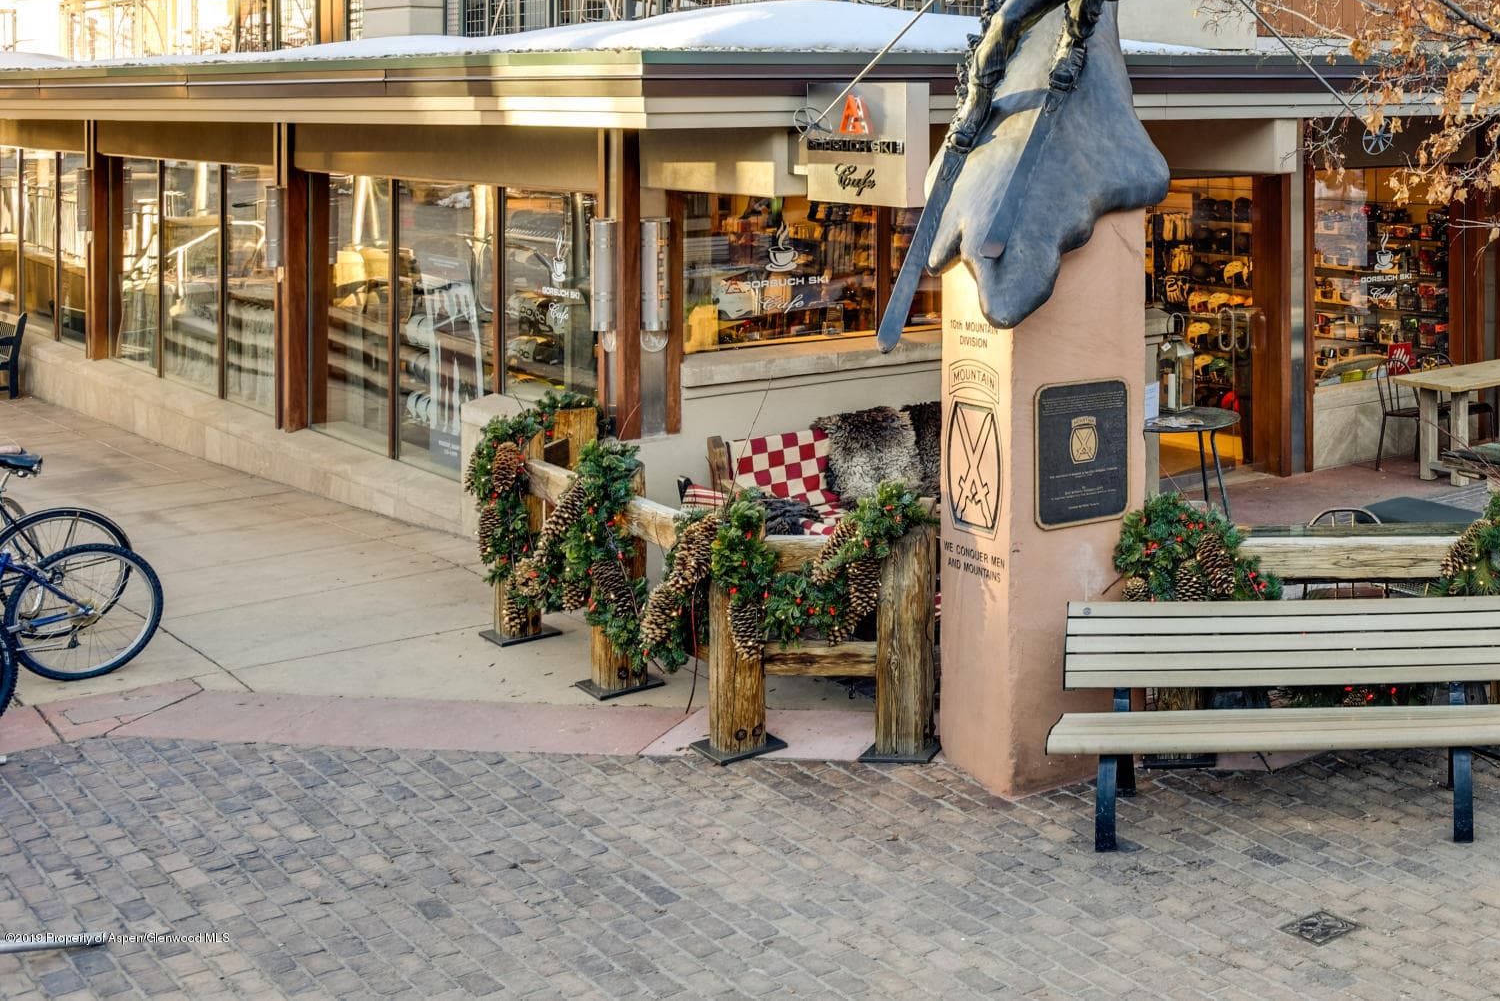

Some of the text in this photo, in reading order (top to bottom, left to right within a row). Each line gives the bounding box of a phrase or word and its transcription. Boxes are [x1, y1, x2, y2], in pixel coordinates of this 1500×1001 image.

[743, 275, 829, 289] GORSUCH SKI
[759, 294, 805, 314] Cafe
[965, 321, 999, 335] MOUNTAIN
[959, 335, 988, 349] DIVISION
[953, 368, 995, 391] MOUNTAIN
[944, 540, 1005, 569] WE CONQUER MEN
[948, 557, 1001, 583] AND MOUNTAINS
